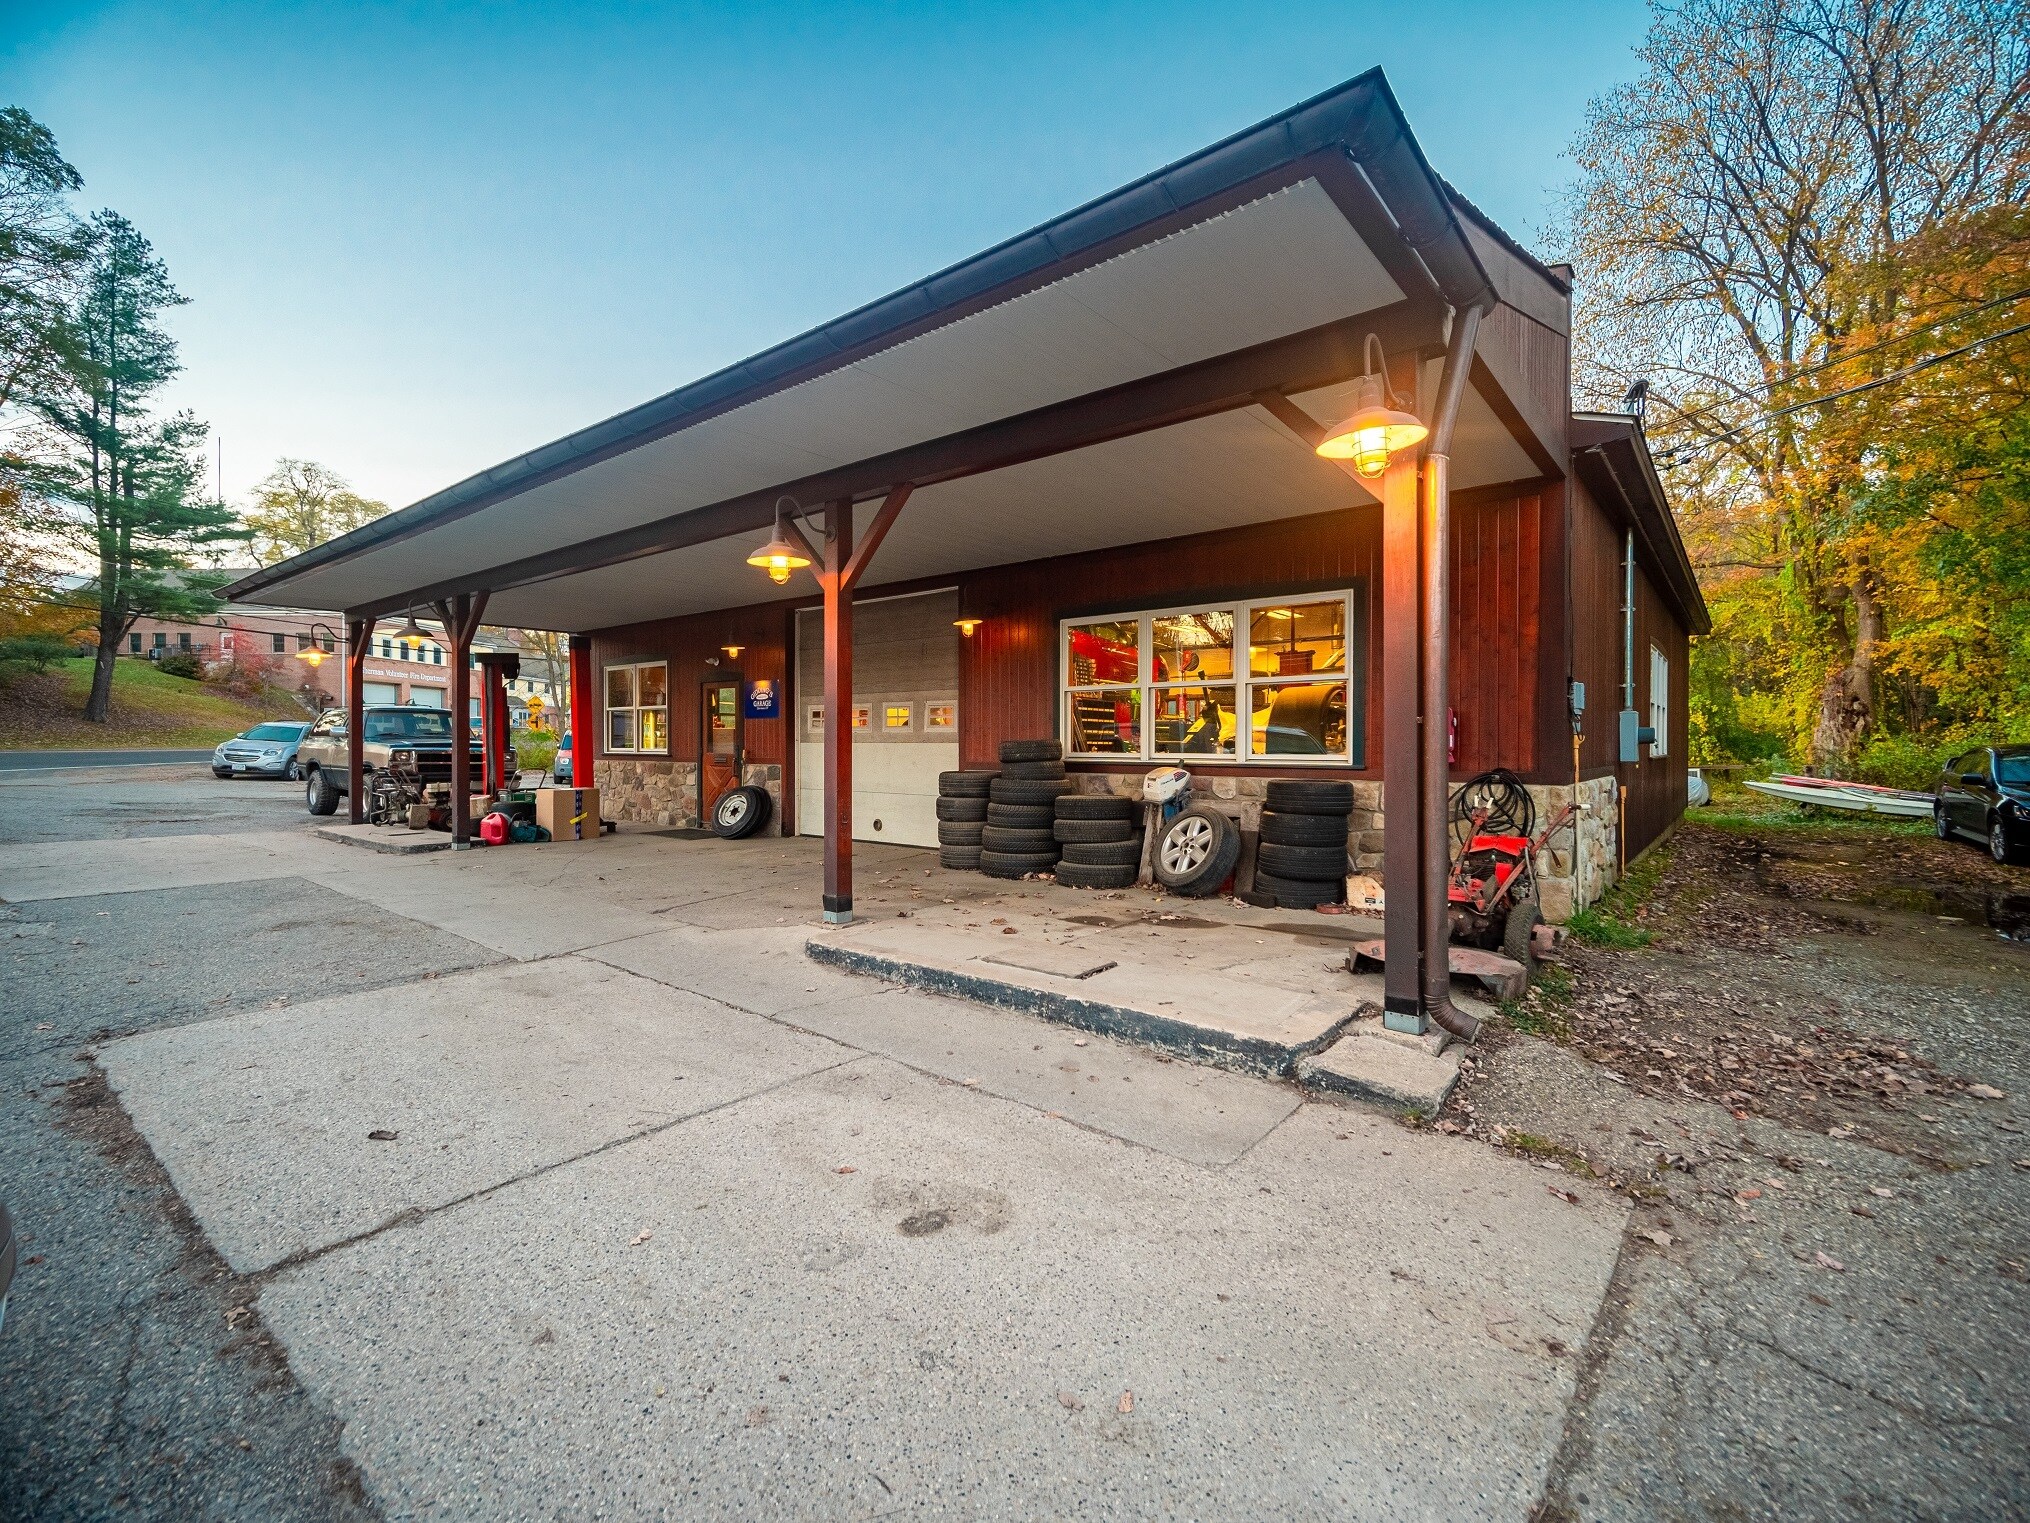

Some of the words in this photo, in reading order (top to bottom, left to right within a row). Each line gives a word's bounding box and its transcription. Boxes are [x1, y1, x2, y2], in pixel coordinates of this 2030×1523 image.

[385, 669, 409, 678] Volunteer
[409, 672, 420, 680] Fire
[420, 673, 447, 682] Department
